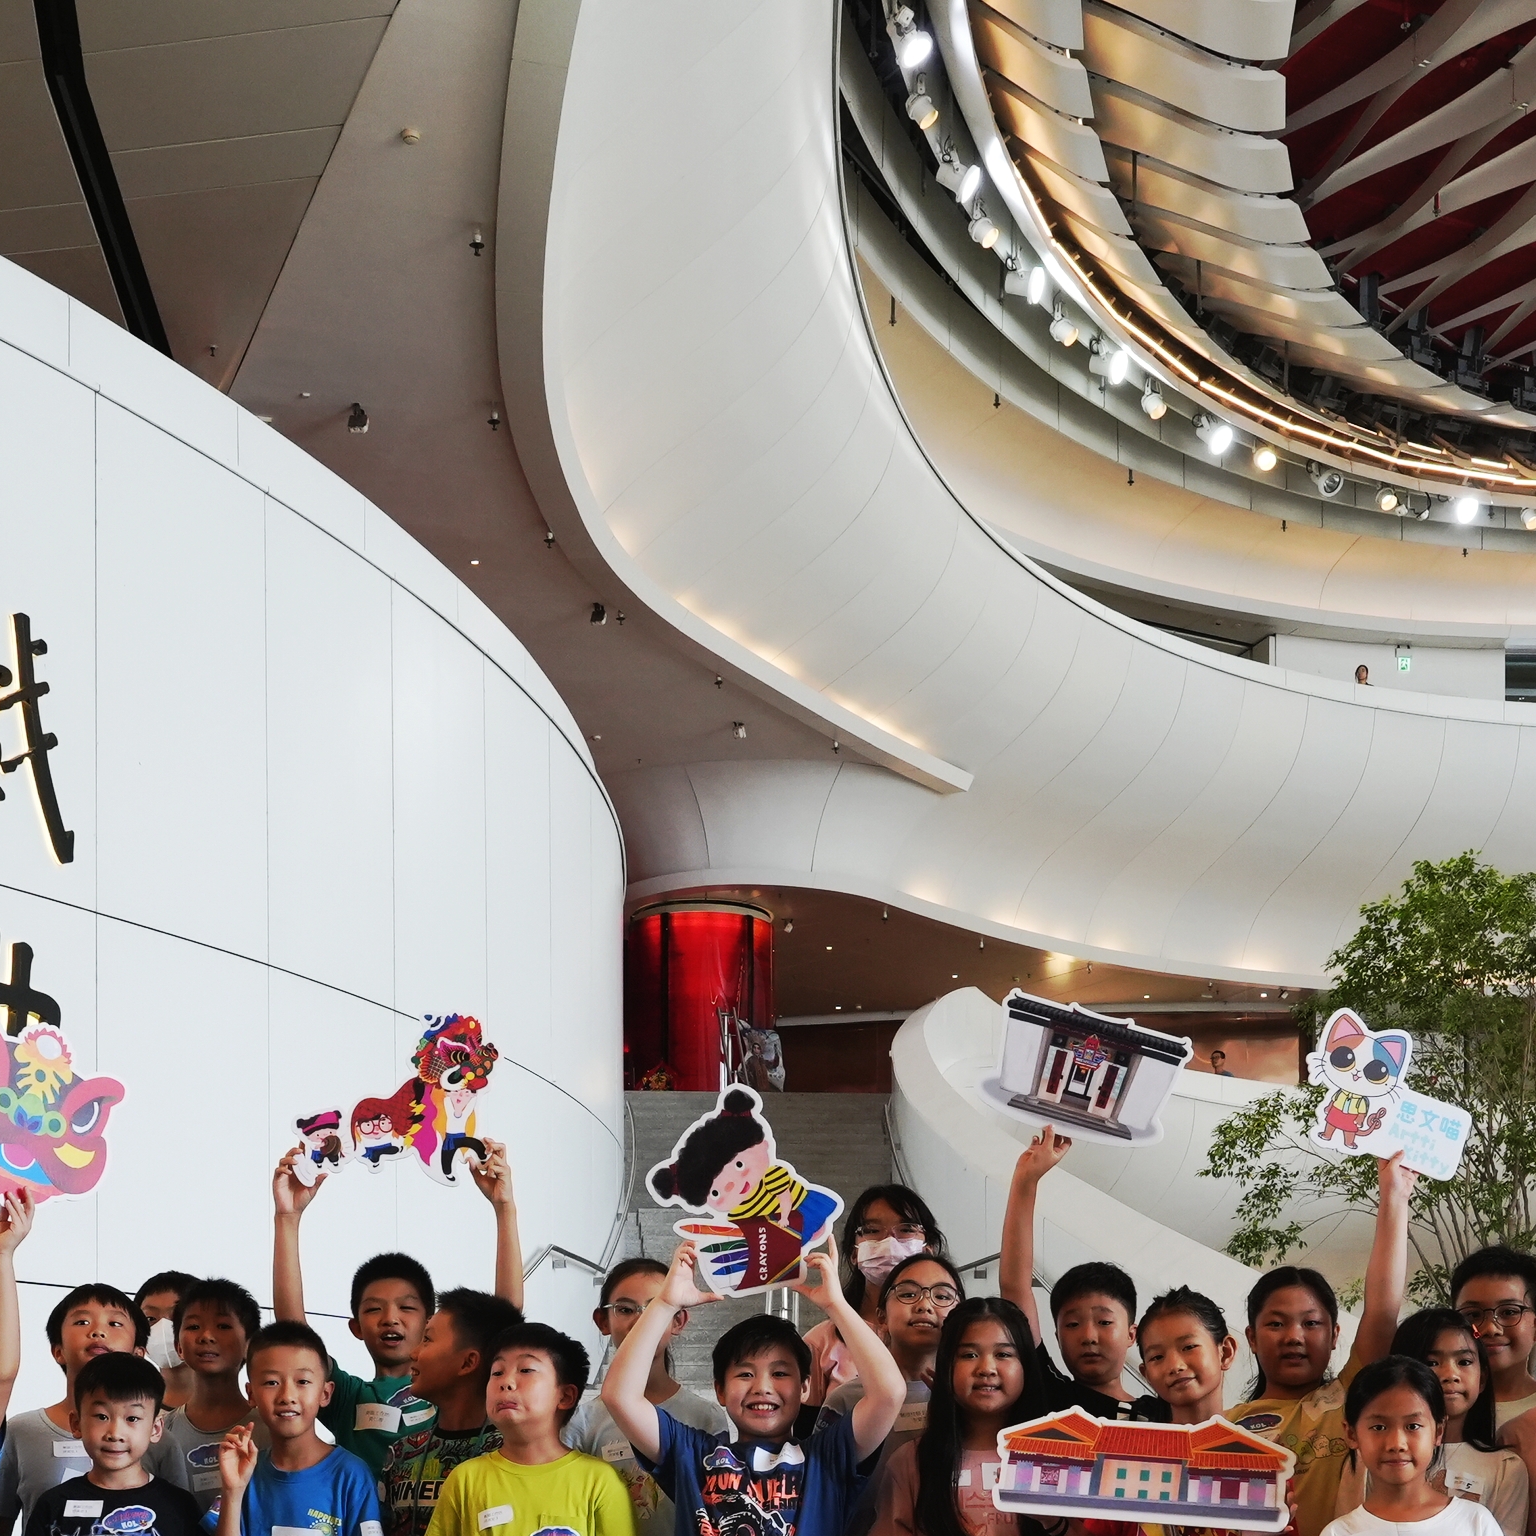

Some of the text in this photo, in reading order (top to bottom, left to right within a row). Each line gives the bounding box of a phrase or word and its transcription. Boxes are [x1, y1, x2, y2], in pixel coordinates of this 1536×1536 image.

[1396, 1100, 1462, 1142] 思文喵
[758, 1227, 768, 1281] CRAYONS
